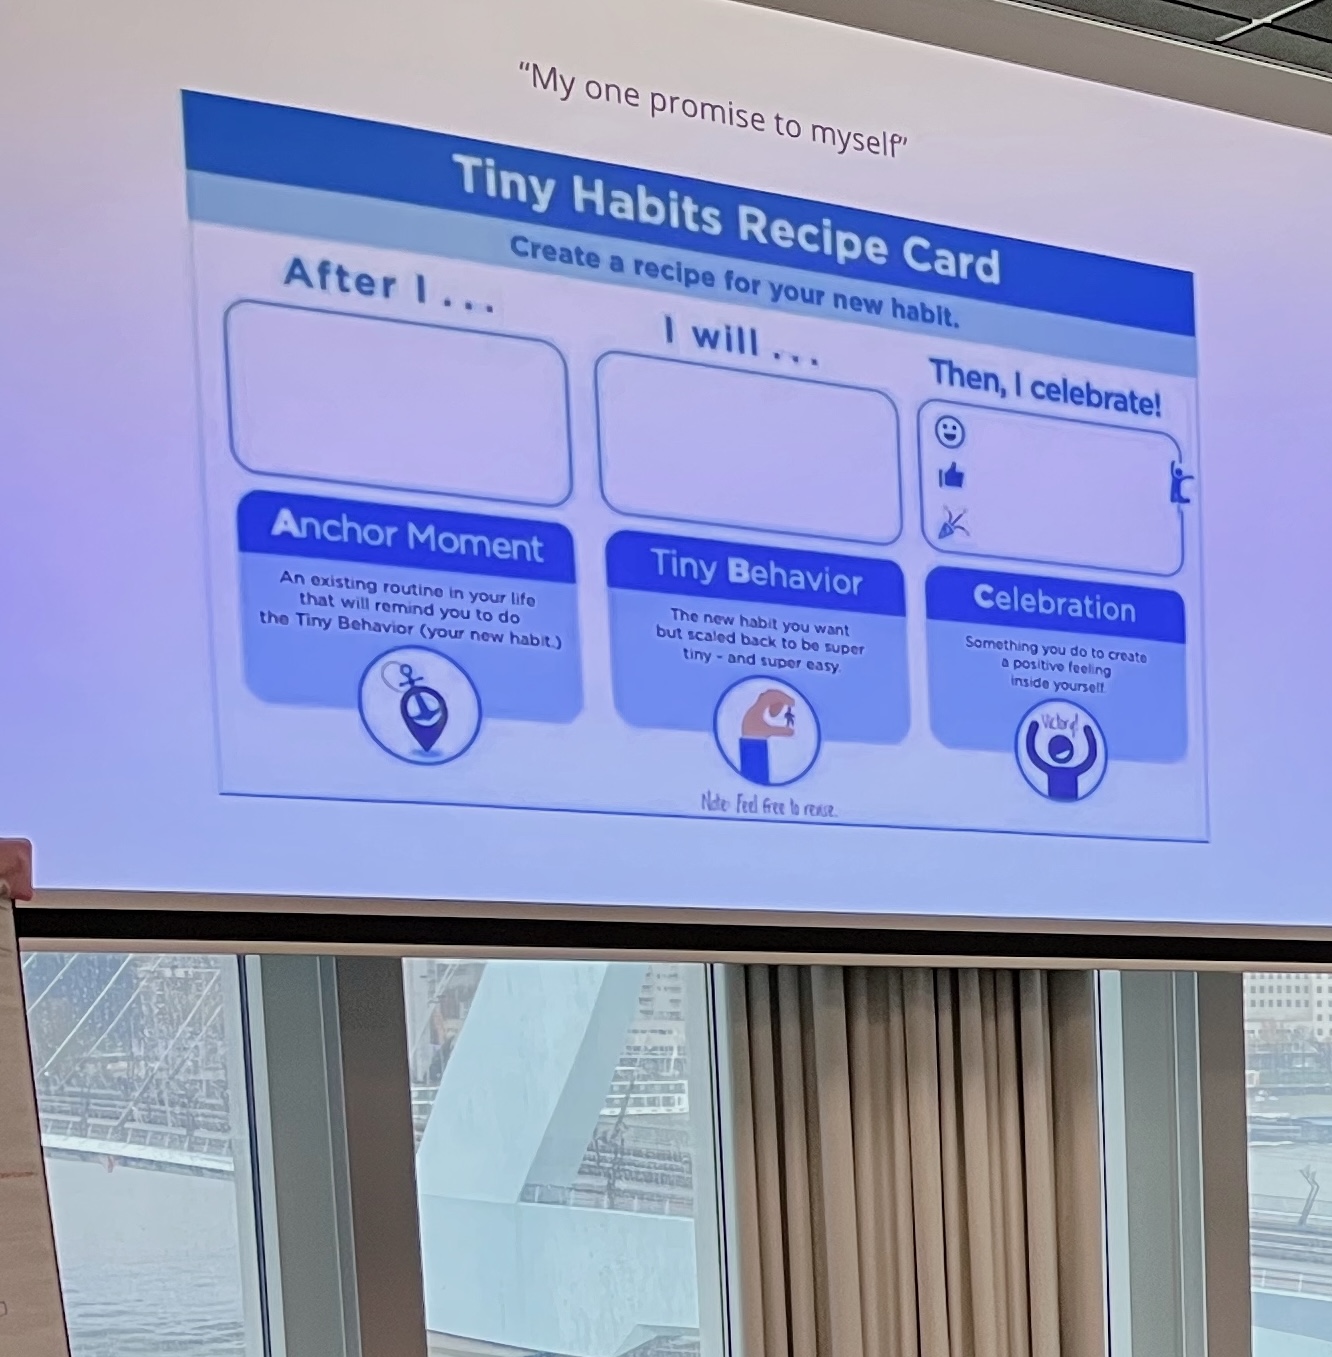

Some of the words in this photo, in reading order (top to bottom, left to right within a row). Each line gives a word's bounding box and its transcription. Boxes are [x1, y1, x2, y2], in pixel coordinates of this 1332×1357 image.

[585, 80, 640, 107] one
[650, 92, 766, 132] promise
[774, 112, 801, 138] to
[451, 153, 557, 214] Tiny
[572, 174, 723, 236] Habits
[738, 204, 889, 265] Recipe
[902, 235, 1001, 285] Card
[284, 256, 397, 299] After
[416, 273, 426, 304] I
[510, 234, 601, 269] Create
[609, 254, 624, 273] a
[633, 256, 716, 288] recipe
[724, 269, 761, 295] for
[767, 280, 826, 306] your
[833, 291, 884, 315] new
[891, 297, 960, 329] habit.
[665, 314, 674, 343] I
[691, 324, 758, 356] will
[928, 357, 1007, 399] Then,
[1015, 370, 1022, 397] I
[1030, 377, 1162, 418] celebrate!
[270, 507, 399, 548] Anchor
[406, 521, 545, 564] Moment
[279, 570, 306, 585] An
[310, 574, 378, 595] existing
[383, 582, 444, 598] routine
[449, 586, 464, 600] in
[468, 590, 507, 604] your
[511, 591, 536, 608] life
[650, 547, 718, 586] Tiny
[727, 556, 864, 596] Behavior
[299, 592, 335, 608] that
[340, 596, 370, 611] will
[375, 600, 434, 617] remind
[440, 606, 471, 621] you
[476, 608, 493, 622] to
[498, 608, 521, 625] do
[670, 606, 699, 623] The
[703, 613, 735, 626] new
[739, 613, 778, 631] habit
[782, 620, 810, 634] you
[814, 624, 850, 637] want
[973, 583, 1137, 623] Celebration
[259, 610, 290, 626] the
[295, 611, 332, 631] Tiny
[338, 615, 414, 636] Behavior
[419, 623, 465, 640] (your
[470, 630, 505, 643] new
[656, 624, 683, 640] but
[687, 629, 736, 645] scaled
[740, 633, 777, 649] back
[781, 636, 797, 651] to
[801, 638, 820, 652] be
[824, 641, 865, 656] super
[683, 647, 712, 664] tiny
[727, 652, 756, 666] and
[760, 656, 802, 670] super
[965, 635, 1039, 656] Something
[1041, 643, 1066, 657] you
[1070, 645, 1087, 658] do
[1091, 647, 1105, 660] to
[1108, 650, 1148, 664] create
[1001, 657, 1009, 668] a
[1013, 658, 1065, 672] positive
[1068, 660, 1112, 679] feeling
[1011, 674, 1050, 690] inside
[736, 792, 758, 814] Feel
[790, 797, 800, 816] to
